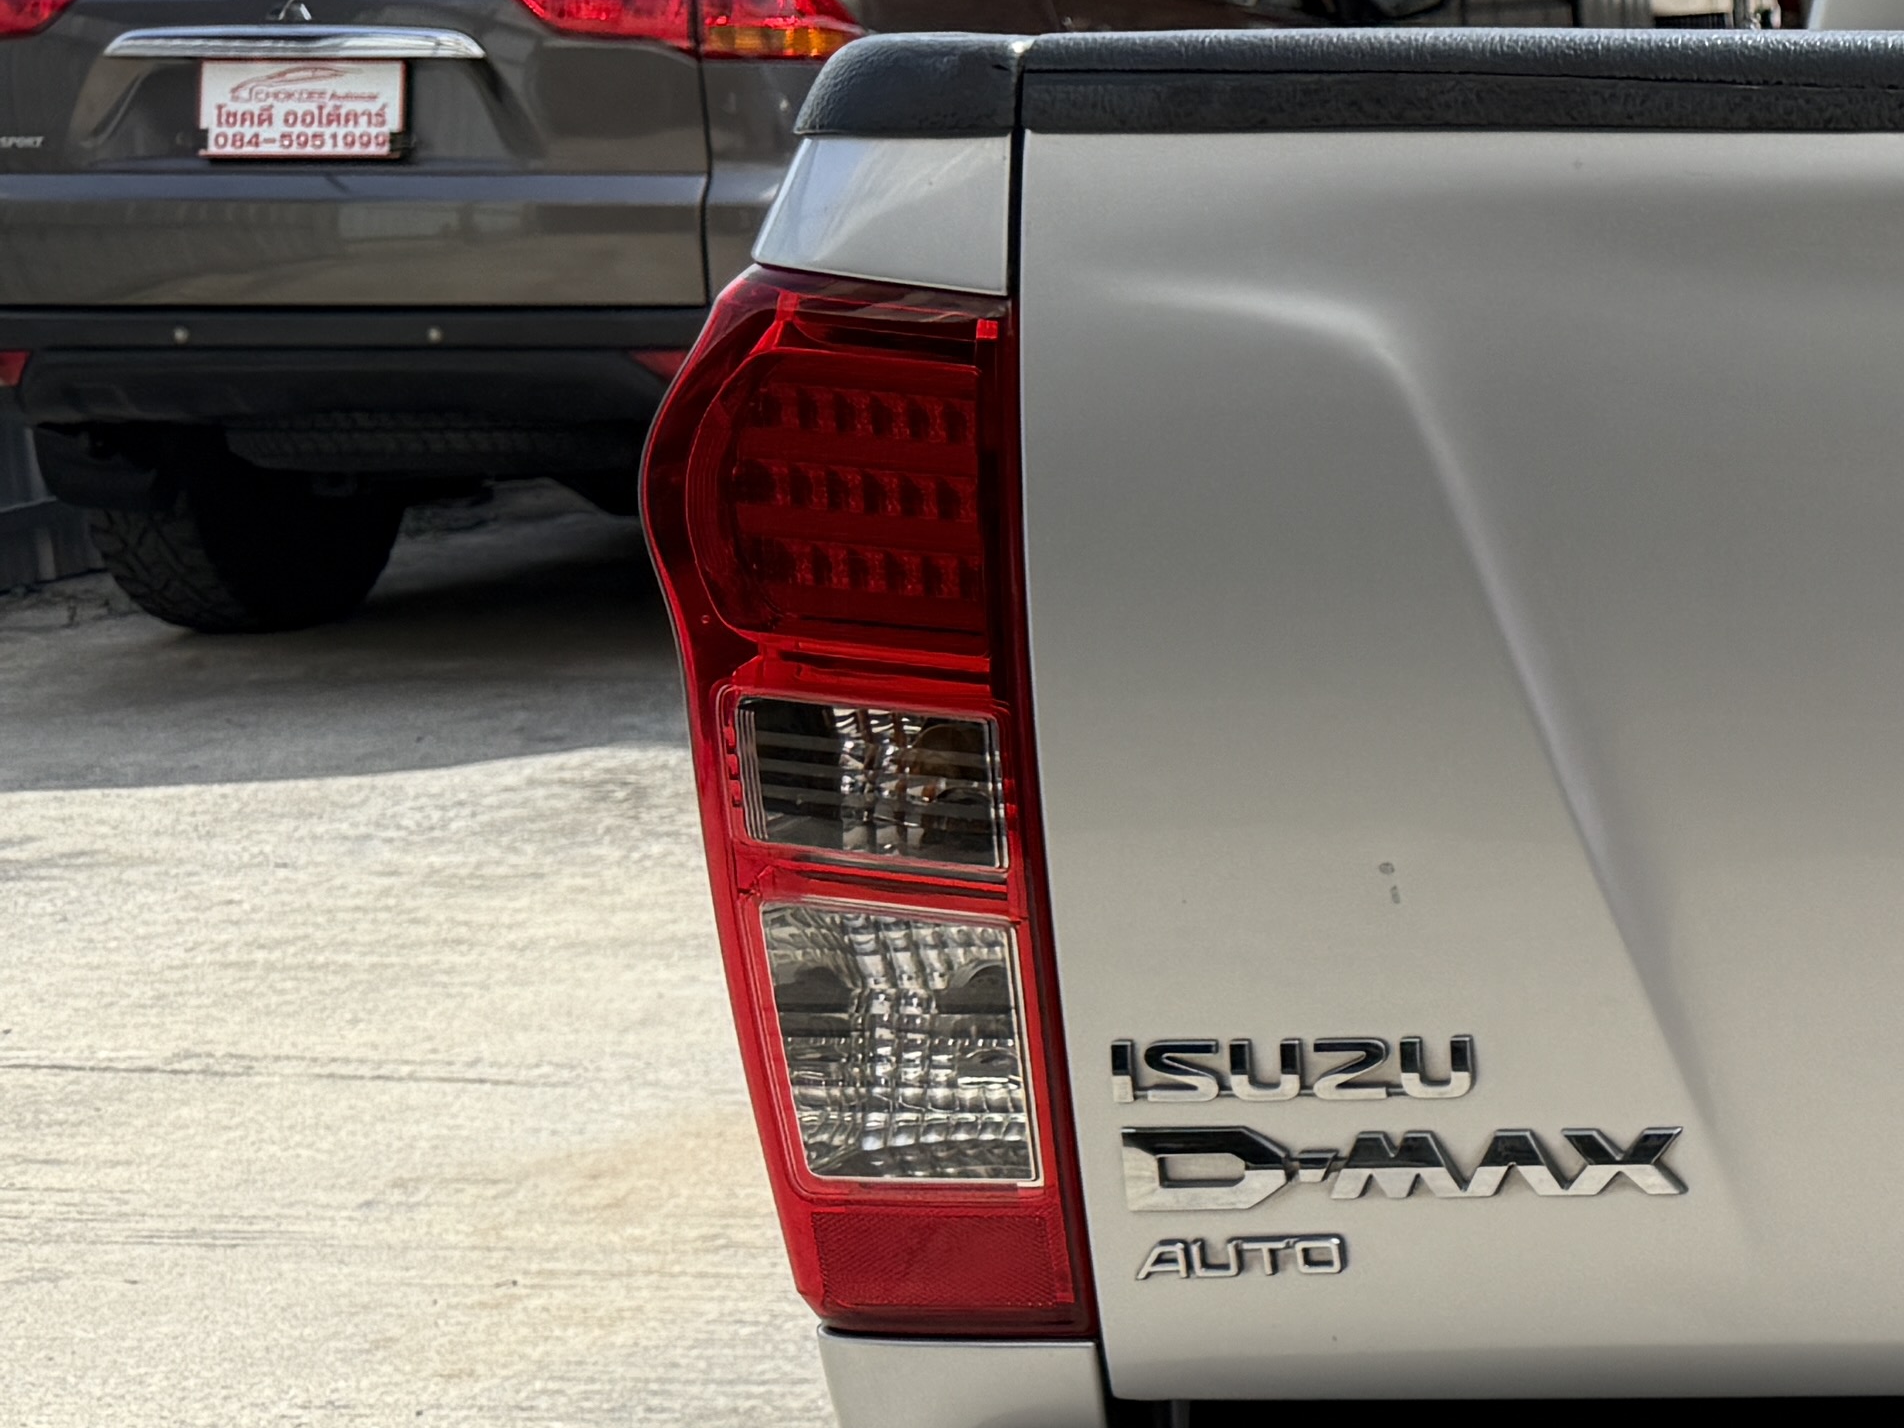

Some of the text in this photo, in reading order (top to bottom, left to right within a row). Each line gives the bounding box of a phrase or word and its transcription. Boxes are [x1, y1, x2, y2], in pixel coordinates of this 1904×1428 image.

[214, 103, 388, 128] โชคดี ออโต้คาร์
[213, 131, 388, 150] 084-5951999
[1110, 1035, 1475, 1103] ISUZU
[1121, 1125, 1689, 1212] D-MAX
[1136, 1233, 1349, 1280] AUTO
